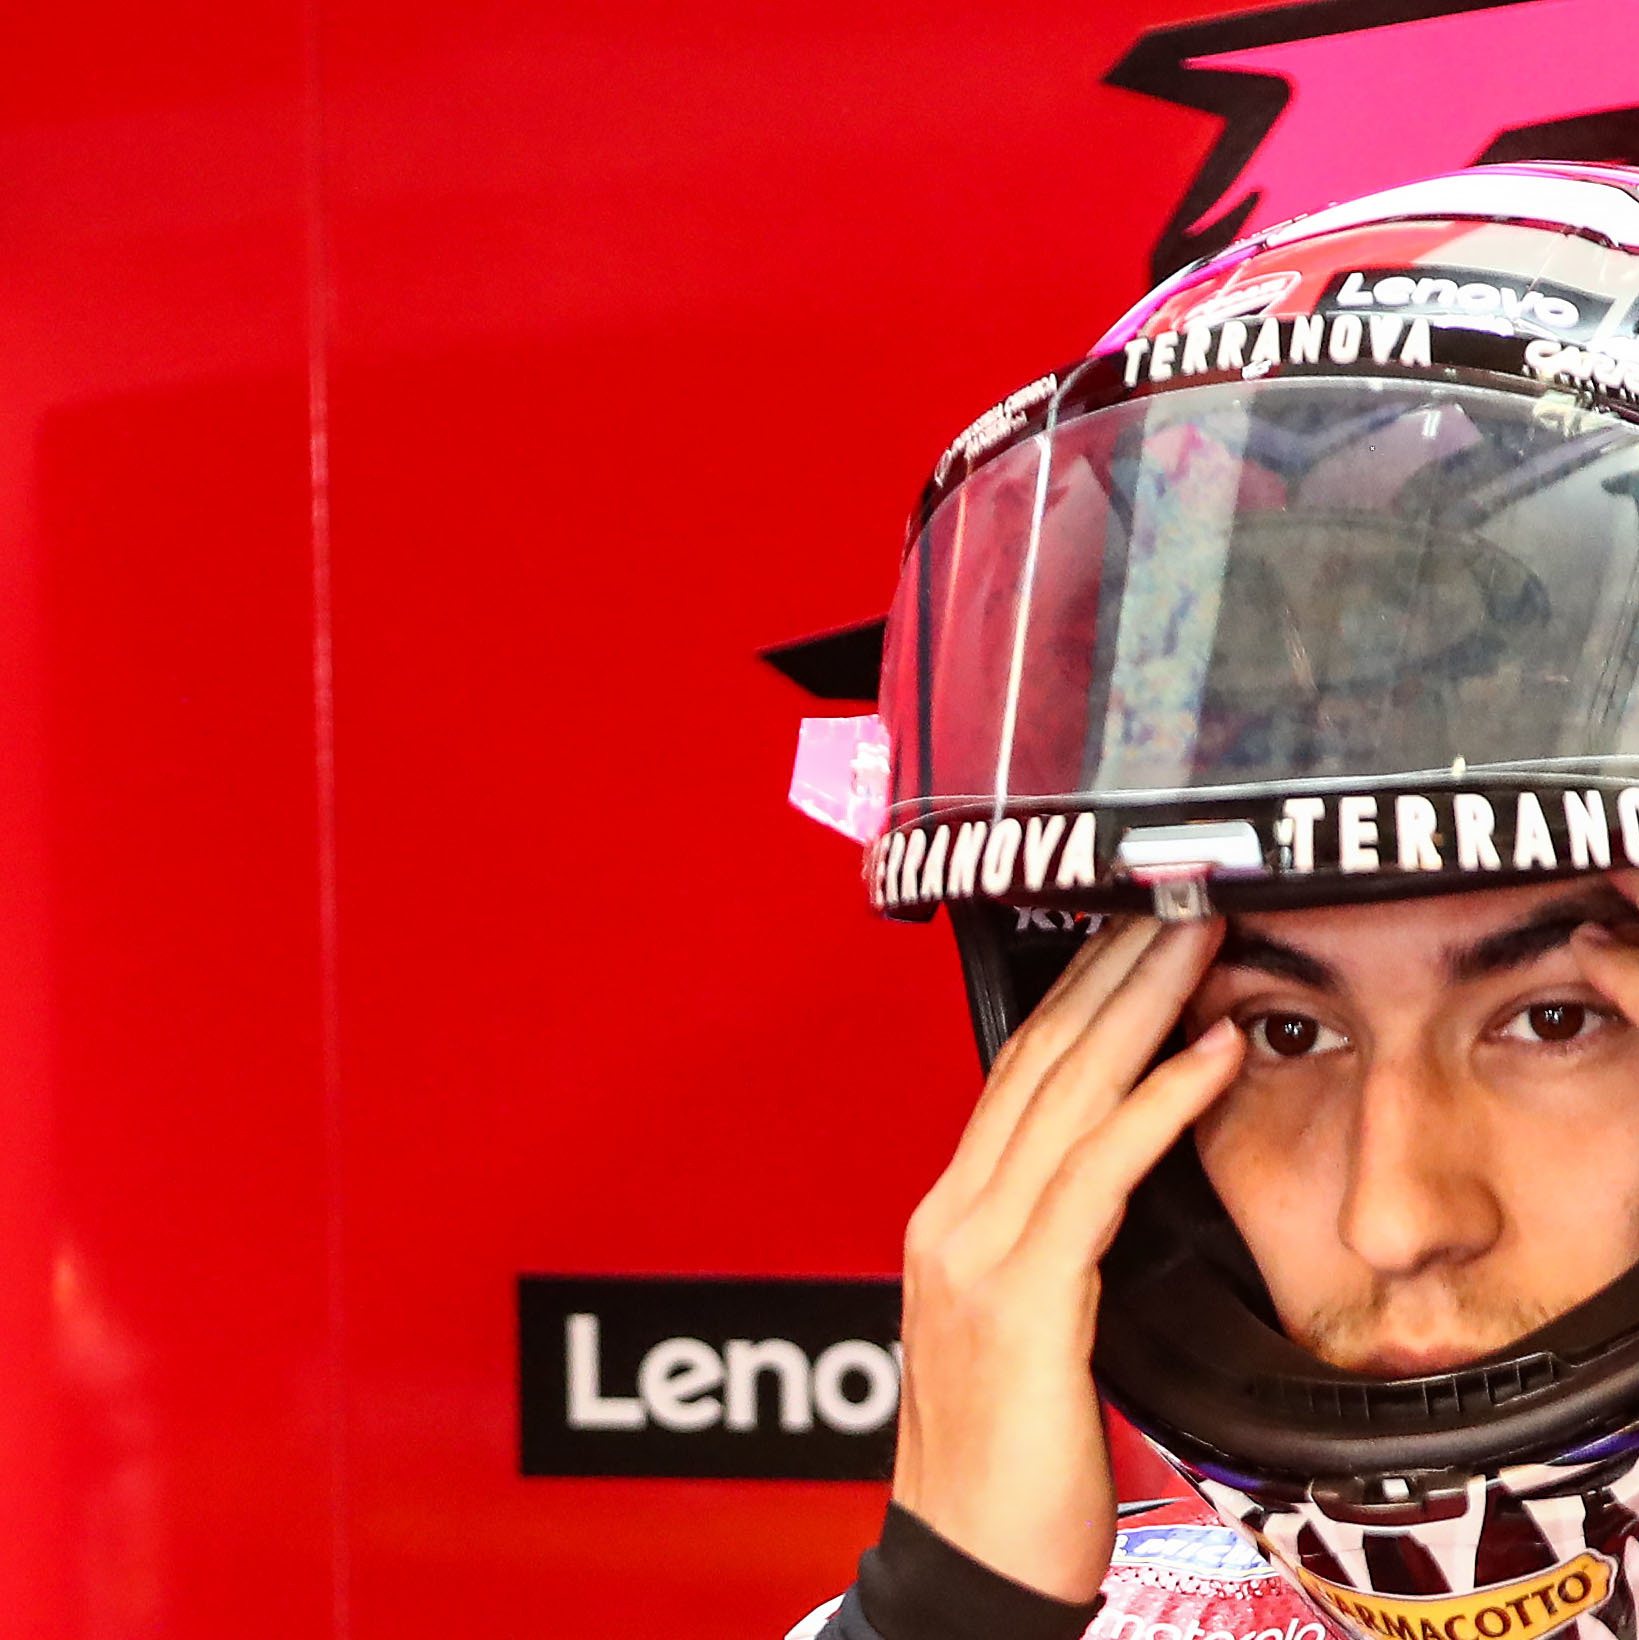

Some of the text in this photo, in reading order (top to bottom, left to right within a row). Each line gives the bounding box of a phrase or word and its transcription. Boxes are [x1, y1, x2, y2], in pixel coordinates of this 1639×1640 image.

[1335, 271, 1581, 329] Lenovo
[1123, 313, 1434, 388] TERRANOVA
[566, 1312, 901, 1433] Leno
